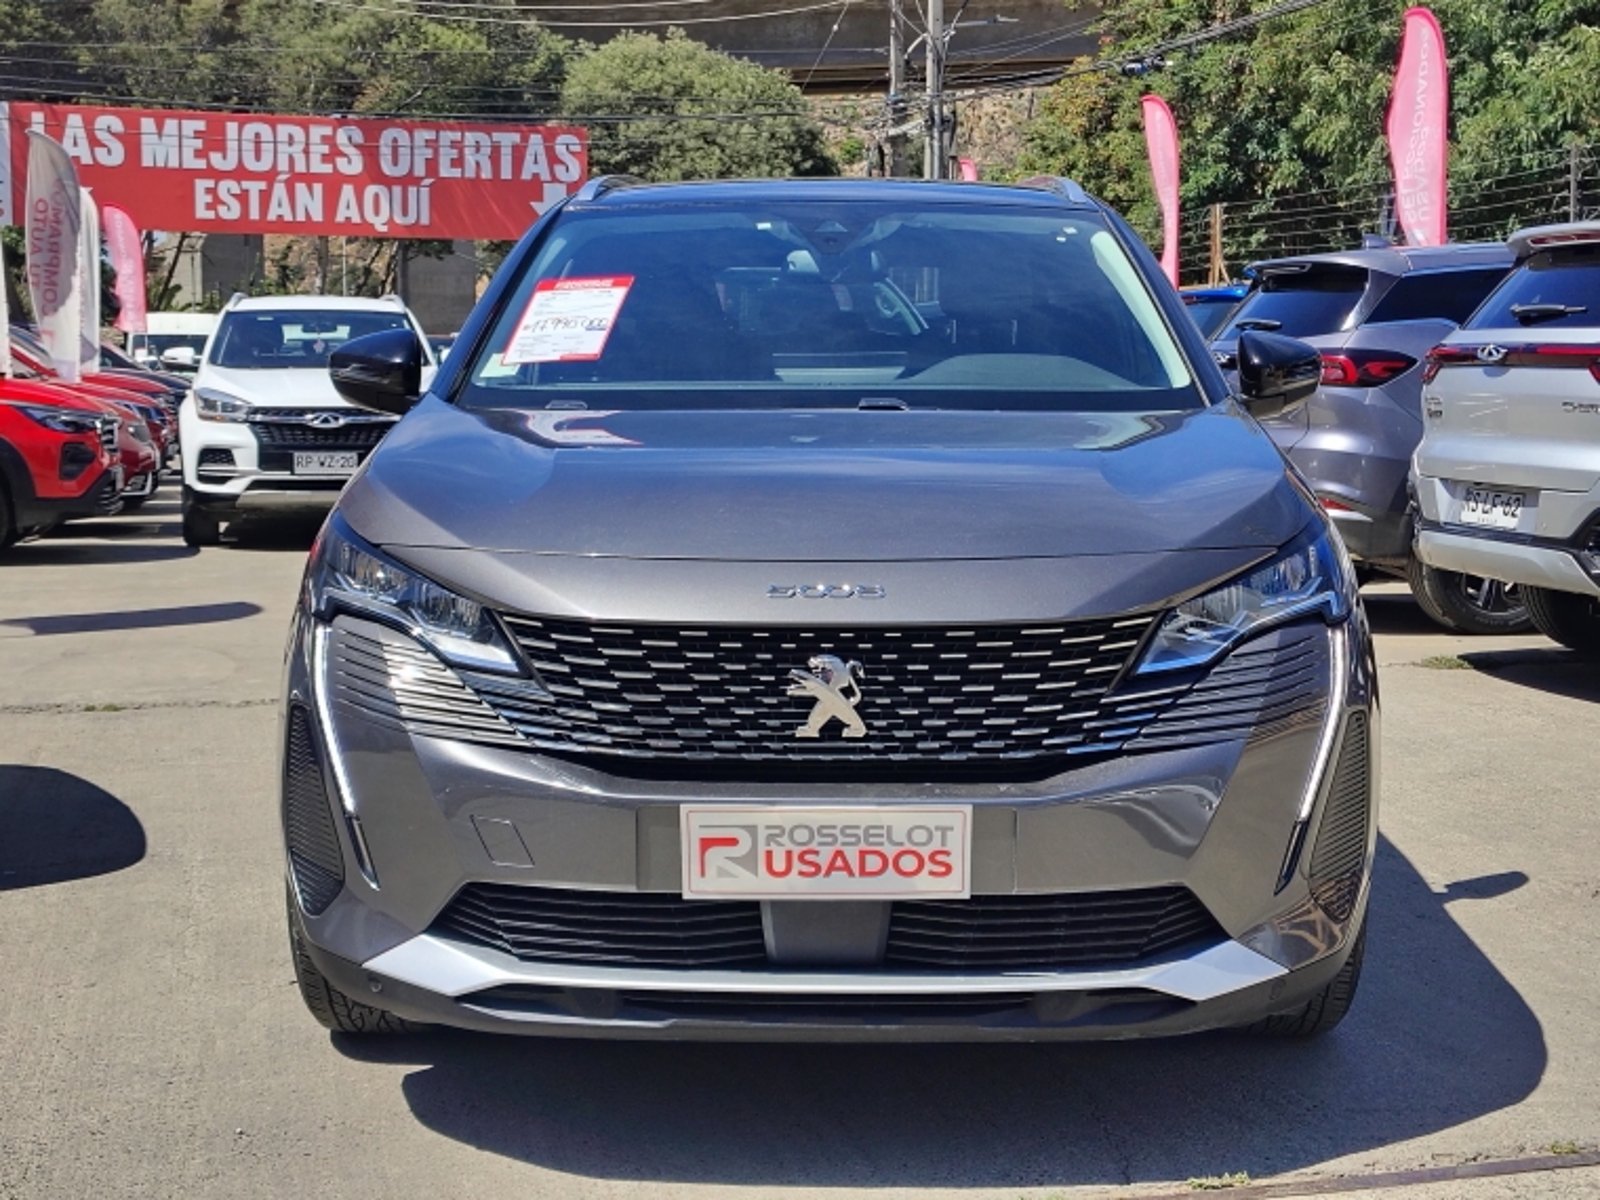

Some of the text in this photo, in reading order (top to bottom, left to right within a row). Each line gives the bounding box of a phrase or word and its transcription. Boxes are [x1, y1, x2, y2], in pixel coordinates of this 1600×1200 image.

[140, 117, 365, 175] MEJORES
[379, 127, 582, 182] OFERTAS
[194, 174, 436, 232] ESTÁN AQUÍ
[765, 824, 954, 848] ROSSELOT
[764, 848, 954, 879] USADOS
